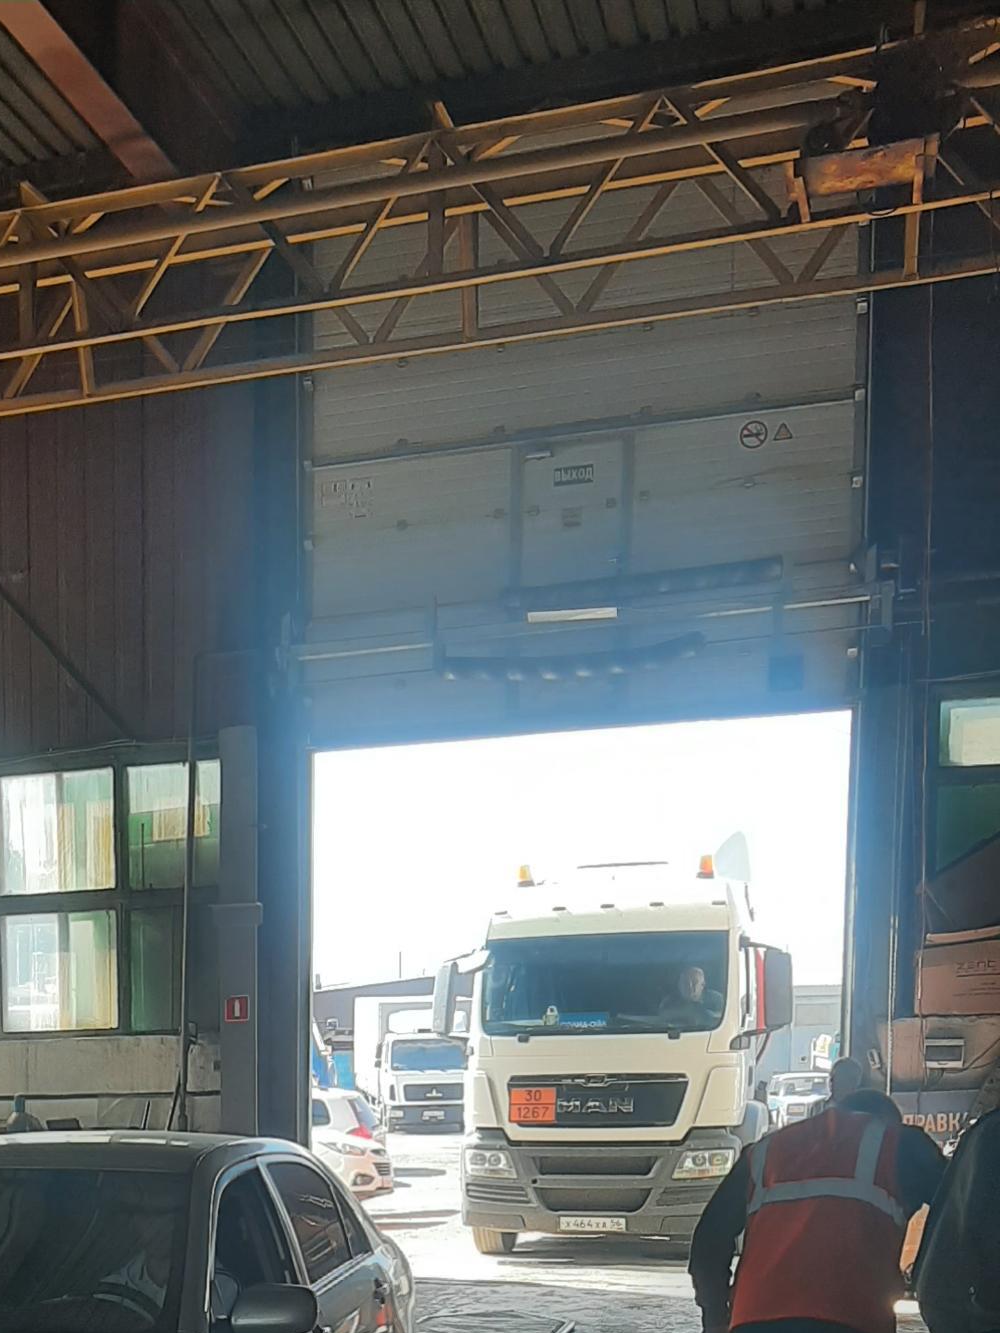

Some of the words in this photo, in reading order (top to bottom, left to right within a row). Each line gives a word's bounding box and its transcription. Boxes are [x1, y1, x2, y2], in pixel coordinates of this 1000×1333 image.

[554, 467, 593, 481] ВЫХОД
[524, 1090, 542, 1101] 30
[557, 1096, 634, 1114] MAN
[517, 1106, 549, 1119] 1267
[903, 1112, 968, 1132] ПРАВК
